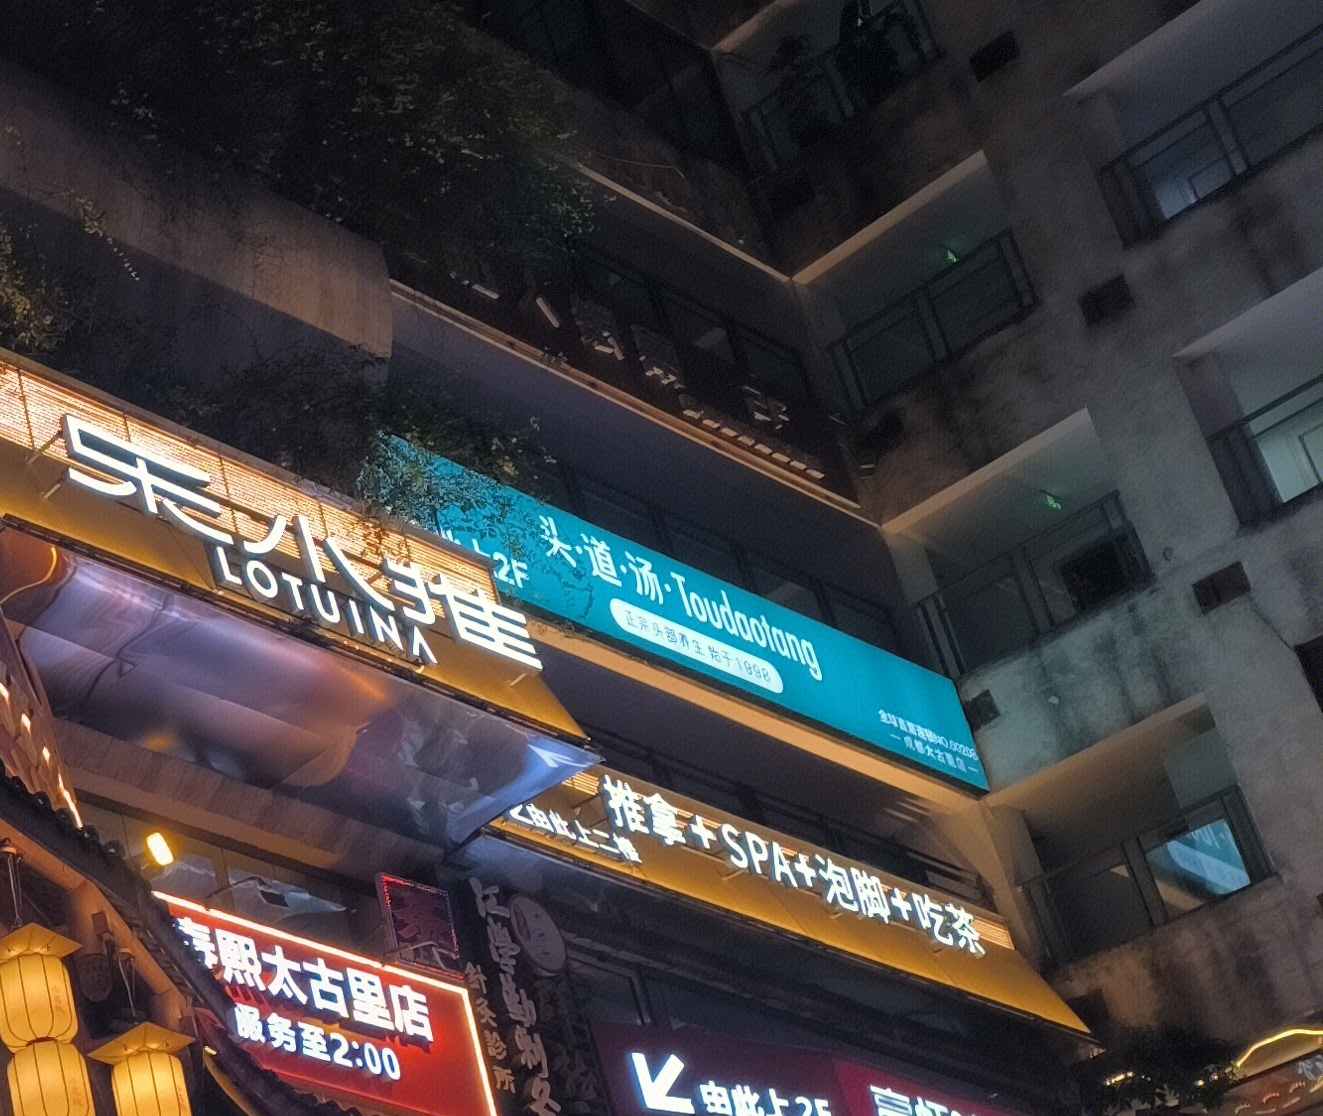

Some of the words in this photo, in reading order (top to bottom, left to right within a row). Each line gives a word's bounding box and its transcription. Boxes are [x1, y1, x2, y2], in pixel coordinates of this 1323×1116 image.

[177, 915, 436, 1042] 春熙太古里店
[234, 1003, 402, 1082] 服务至2:00
